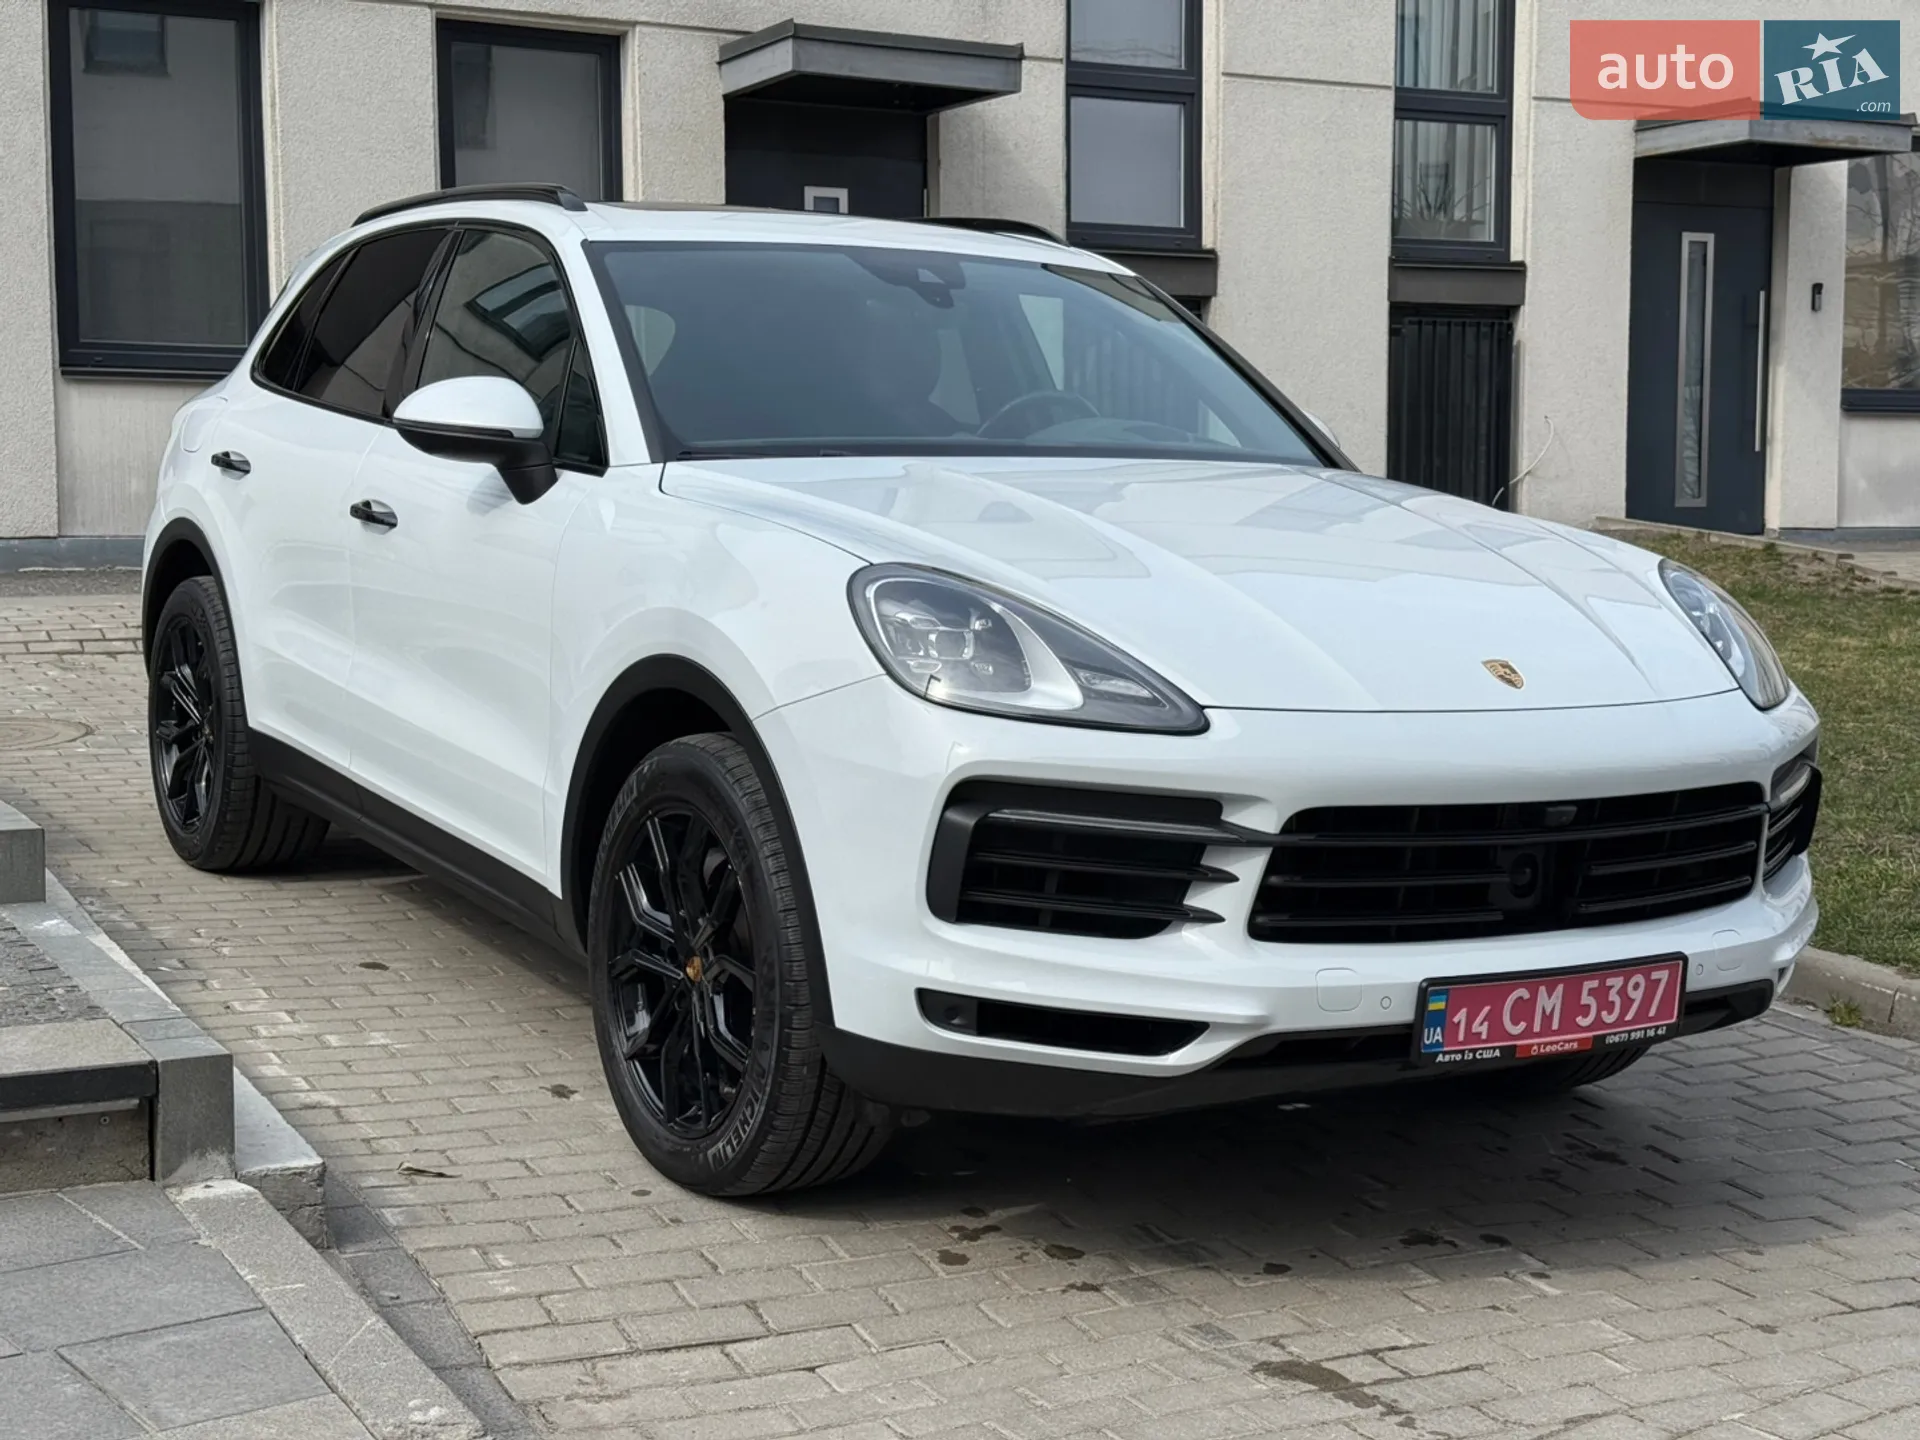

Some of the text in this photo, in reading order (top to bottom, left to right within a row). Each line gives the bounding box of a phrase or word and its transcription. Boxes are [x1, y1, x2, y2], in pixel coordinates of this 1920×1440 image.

[1452, 970, 1670, 1042] 14 CM 5397
[1424, 1026, 1444, 1045] UA
[1435, 1049, 1462, 1063] Авто
[1475, 1048, 1501, 1060] США
[1539, 1040, 1578, 1054] LeoCars
